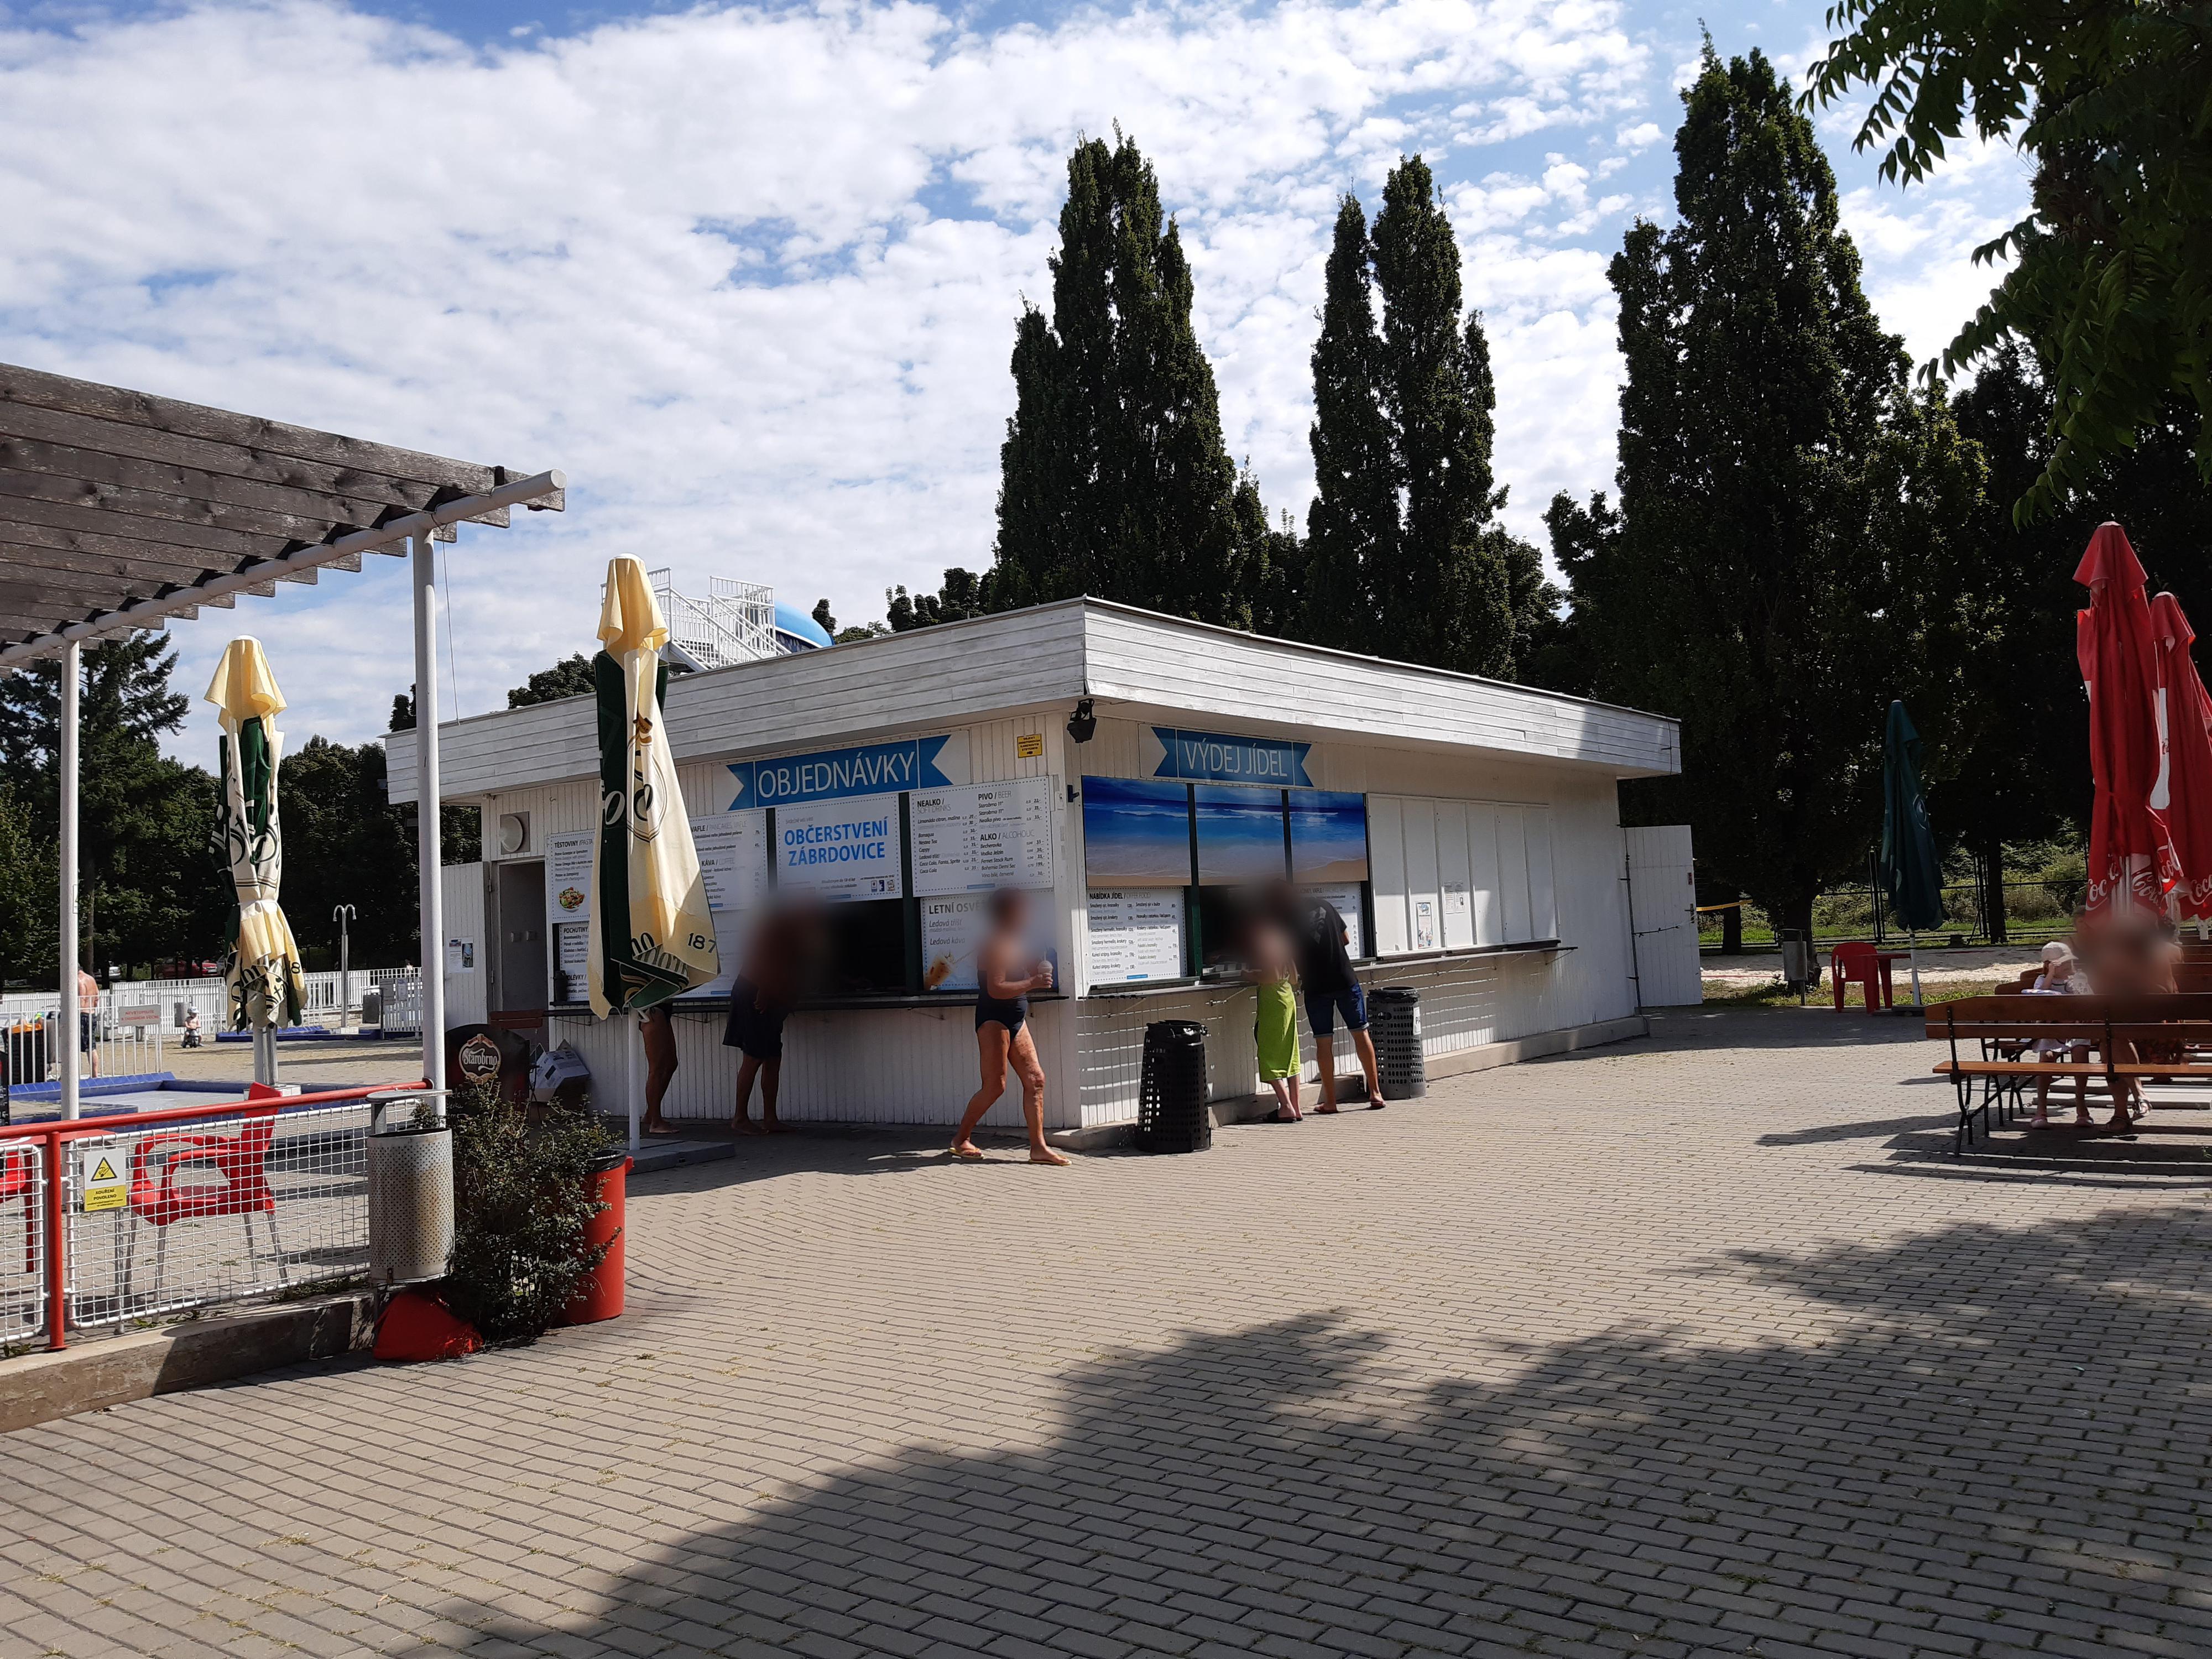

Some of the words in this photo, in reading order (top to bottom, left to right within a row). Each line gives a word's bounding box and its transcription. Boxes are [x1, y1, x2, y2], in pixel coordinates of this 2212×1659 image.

[1185, 738, 1240, 773] VÝDEJ
[1245, 743, 1287, 776] JÍDEL
[758, 752, 915, 798] OBJEDNÁVKY
[998, 790, 1011, 799] BEER
[917, 799, 941, 807] NEALKO
[785, 816, 888, 846] OBČERSTVENÍ
[1003, 830, 1035, 839] ALCOHOLIC
[555, 840, 578, 848] TĚSTOVINY
[789, 842, 885, 866] ZÁBRDOVICE
[929, 902, 954, 914] LETNÍ
[929, 919, 950, 927] Ledová
[462, 1048, 498, 1071] Starobrno
